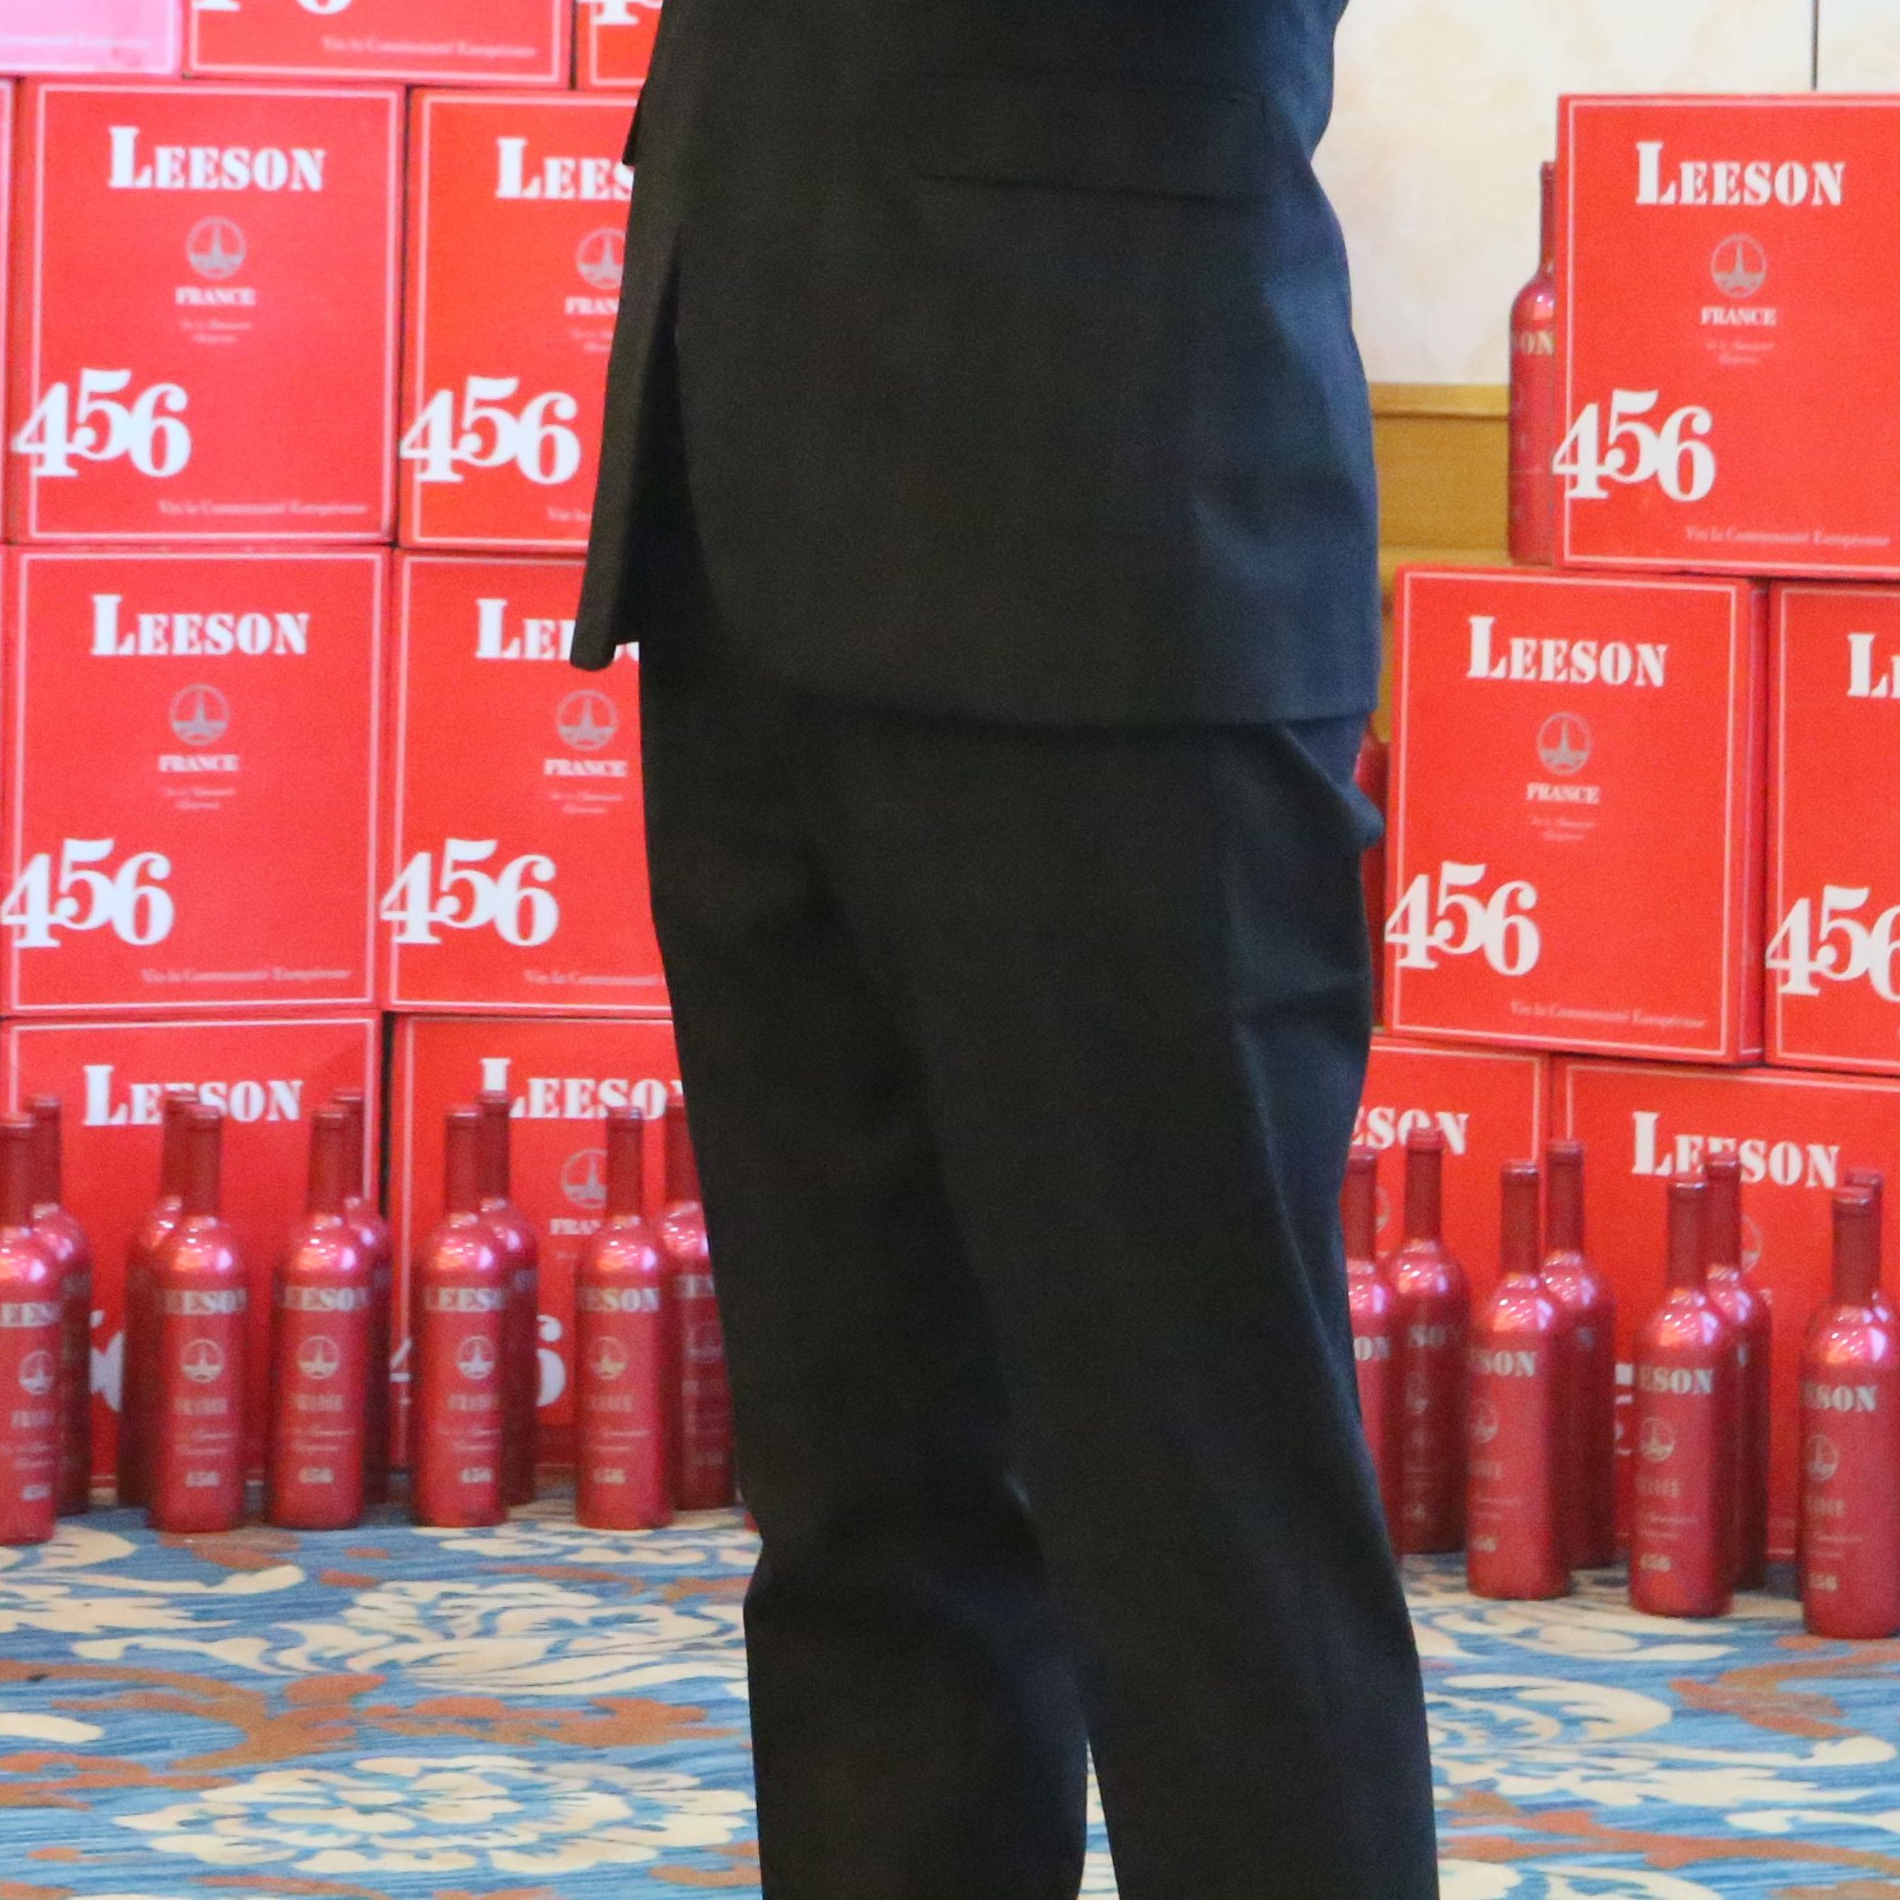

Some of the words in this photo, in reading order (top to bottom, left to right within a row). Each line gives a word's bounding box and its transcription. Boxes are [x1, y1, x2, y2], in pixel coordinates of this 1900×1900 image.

[109, 126, 325, 191] LEESON
[496, 136, 635, 201] LEES
[1636, 141, 1844, 206] LEESON
[176, 287, 256, 306] FRANCE
[564, 296, 621, 316] FRAN
[1701, 306, 1776, 326] FRANCE
[12, 368, 191, 479] 456
[399, 376, 580, 485] 456
[1552, 388, 1715, 503] 456
[91, 594, 309, 656] LEESON
[1467, 616, 1667, 687] LEESON
[159, 754, 239, 772] FRANCE
[544, 759, 627, 777] FRANCE
[1526, 783, 1600, 804] FRANCE
[0, 837, 174, 950] 456
[380, 837, 559, 947] 456
[1385, 861, 1540, 976] 456
[480, 1057, 684, 1120] LEESO
